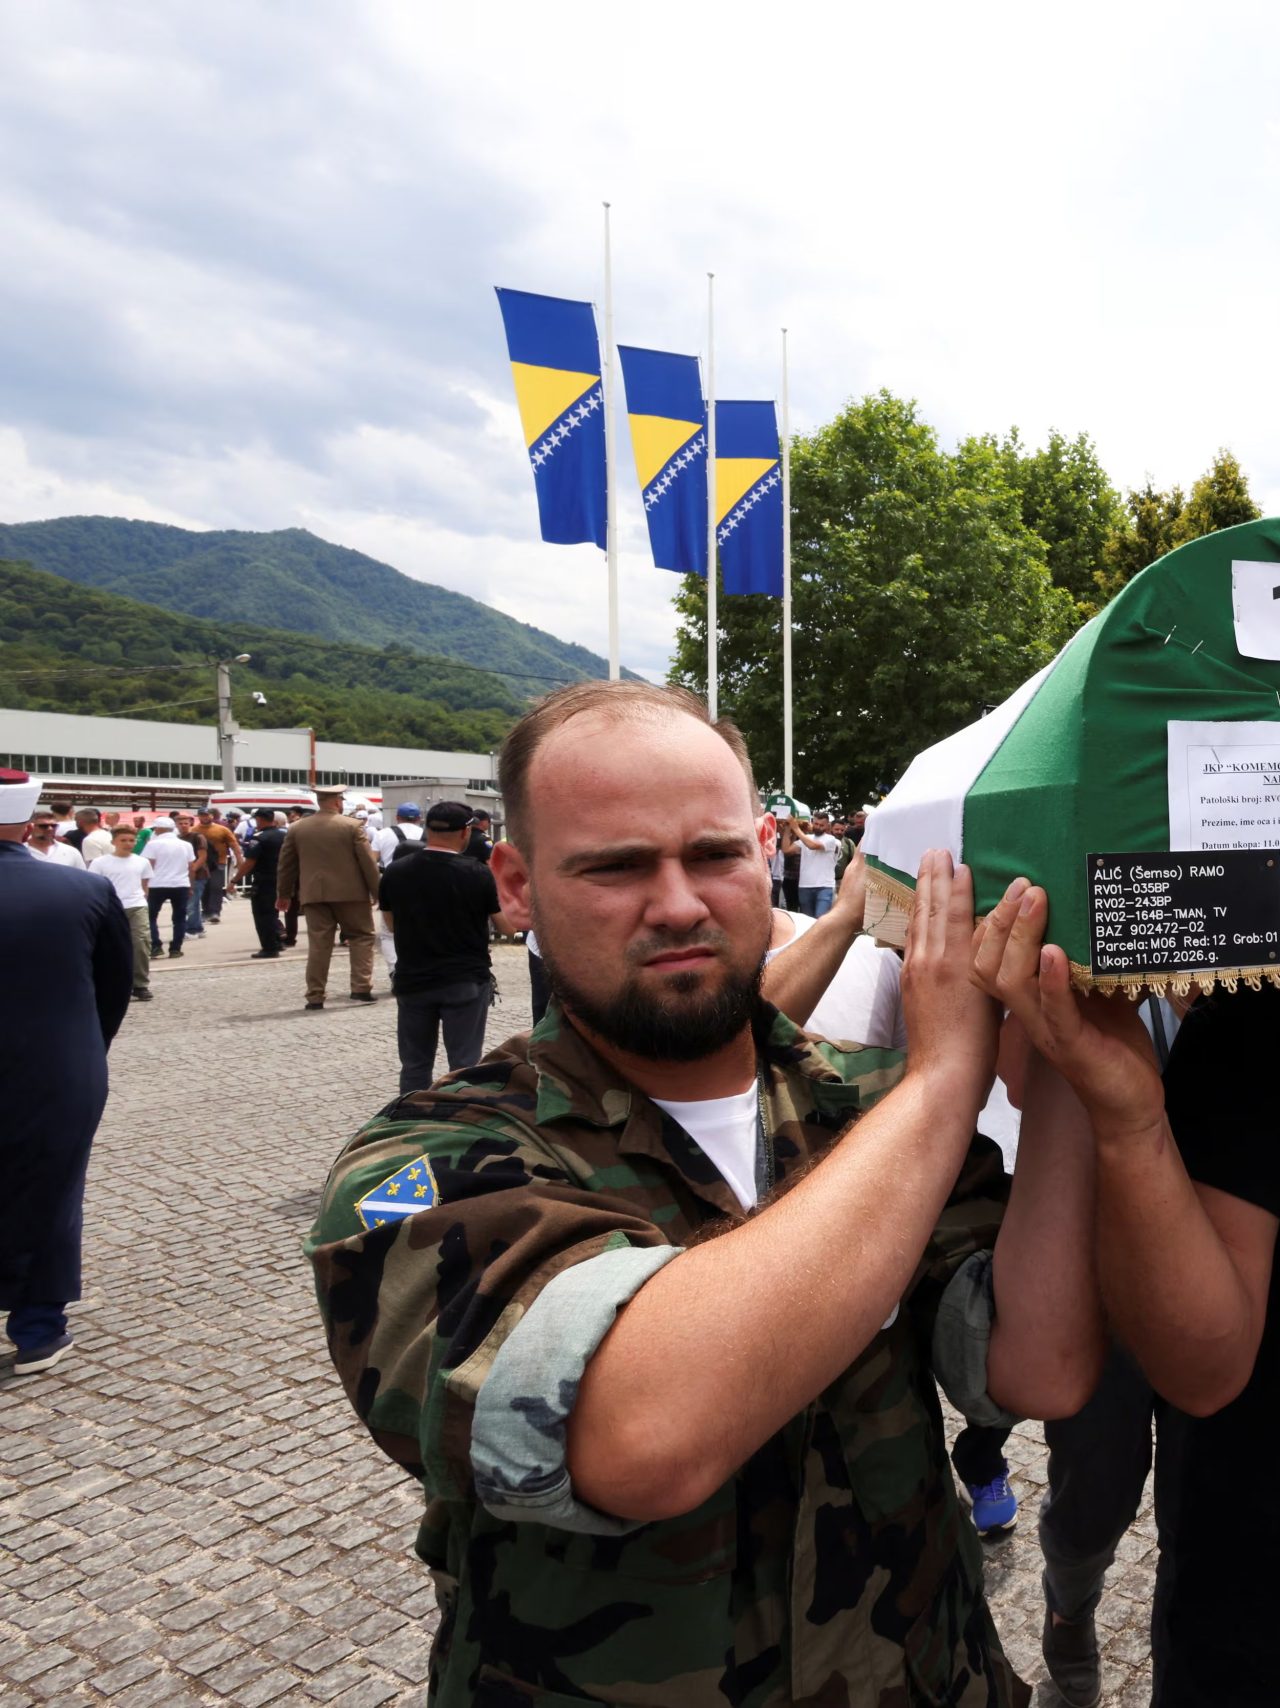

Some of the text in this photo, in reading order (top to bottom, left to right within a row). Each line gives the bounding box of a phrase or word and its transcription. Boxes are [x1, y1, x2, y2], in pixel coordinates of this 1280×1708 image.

[1203, 763, 1224, 772] JKP
[1200, 795, 1239, 804] Patološki
[1241, 795, 1262, 805] broj:
[1201, 818, 1238, 827] Prezime,
[1240, 818, 1255, 826] ime
[1272, 817, 1276, 825] i
[1202, 841, 1230, 850] Datum
[1232, 840, 1260, 850] ukopa:
[1094, 865, 1225, 882] ALIĆ (Šemso) RAMO
[1094, 882, 1170, 895] RV01-035BP
[1095, 896, 1172, 909] RV02-243BP
[1095, 906, 1228, 922] RV02-164B-TMAN, TV
[1096, 921, 1205, 938] BAZ 902472-02
